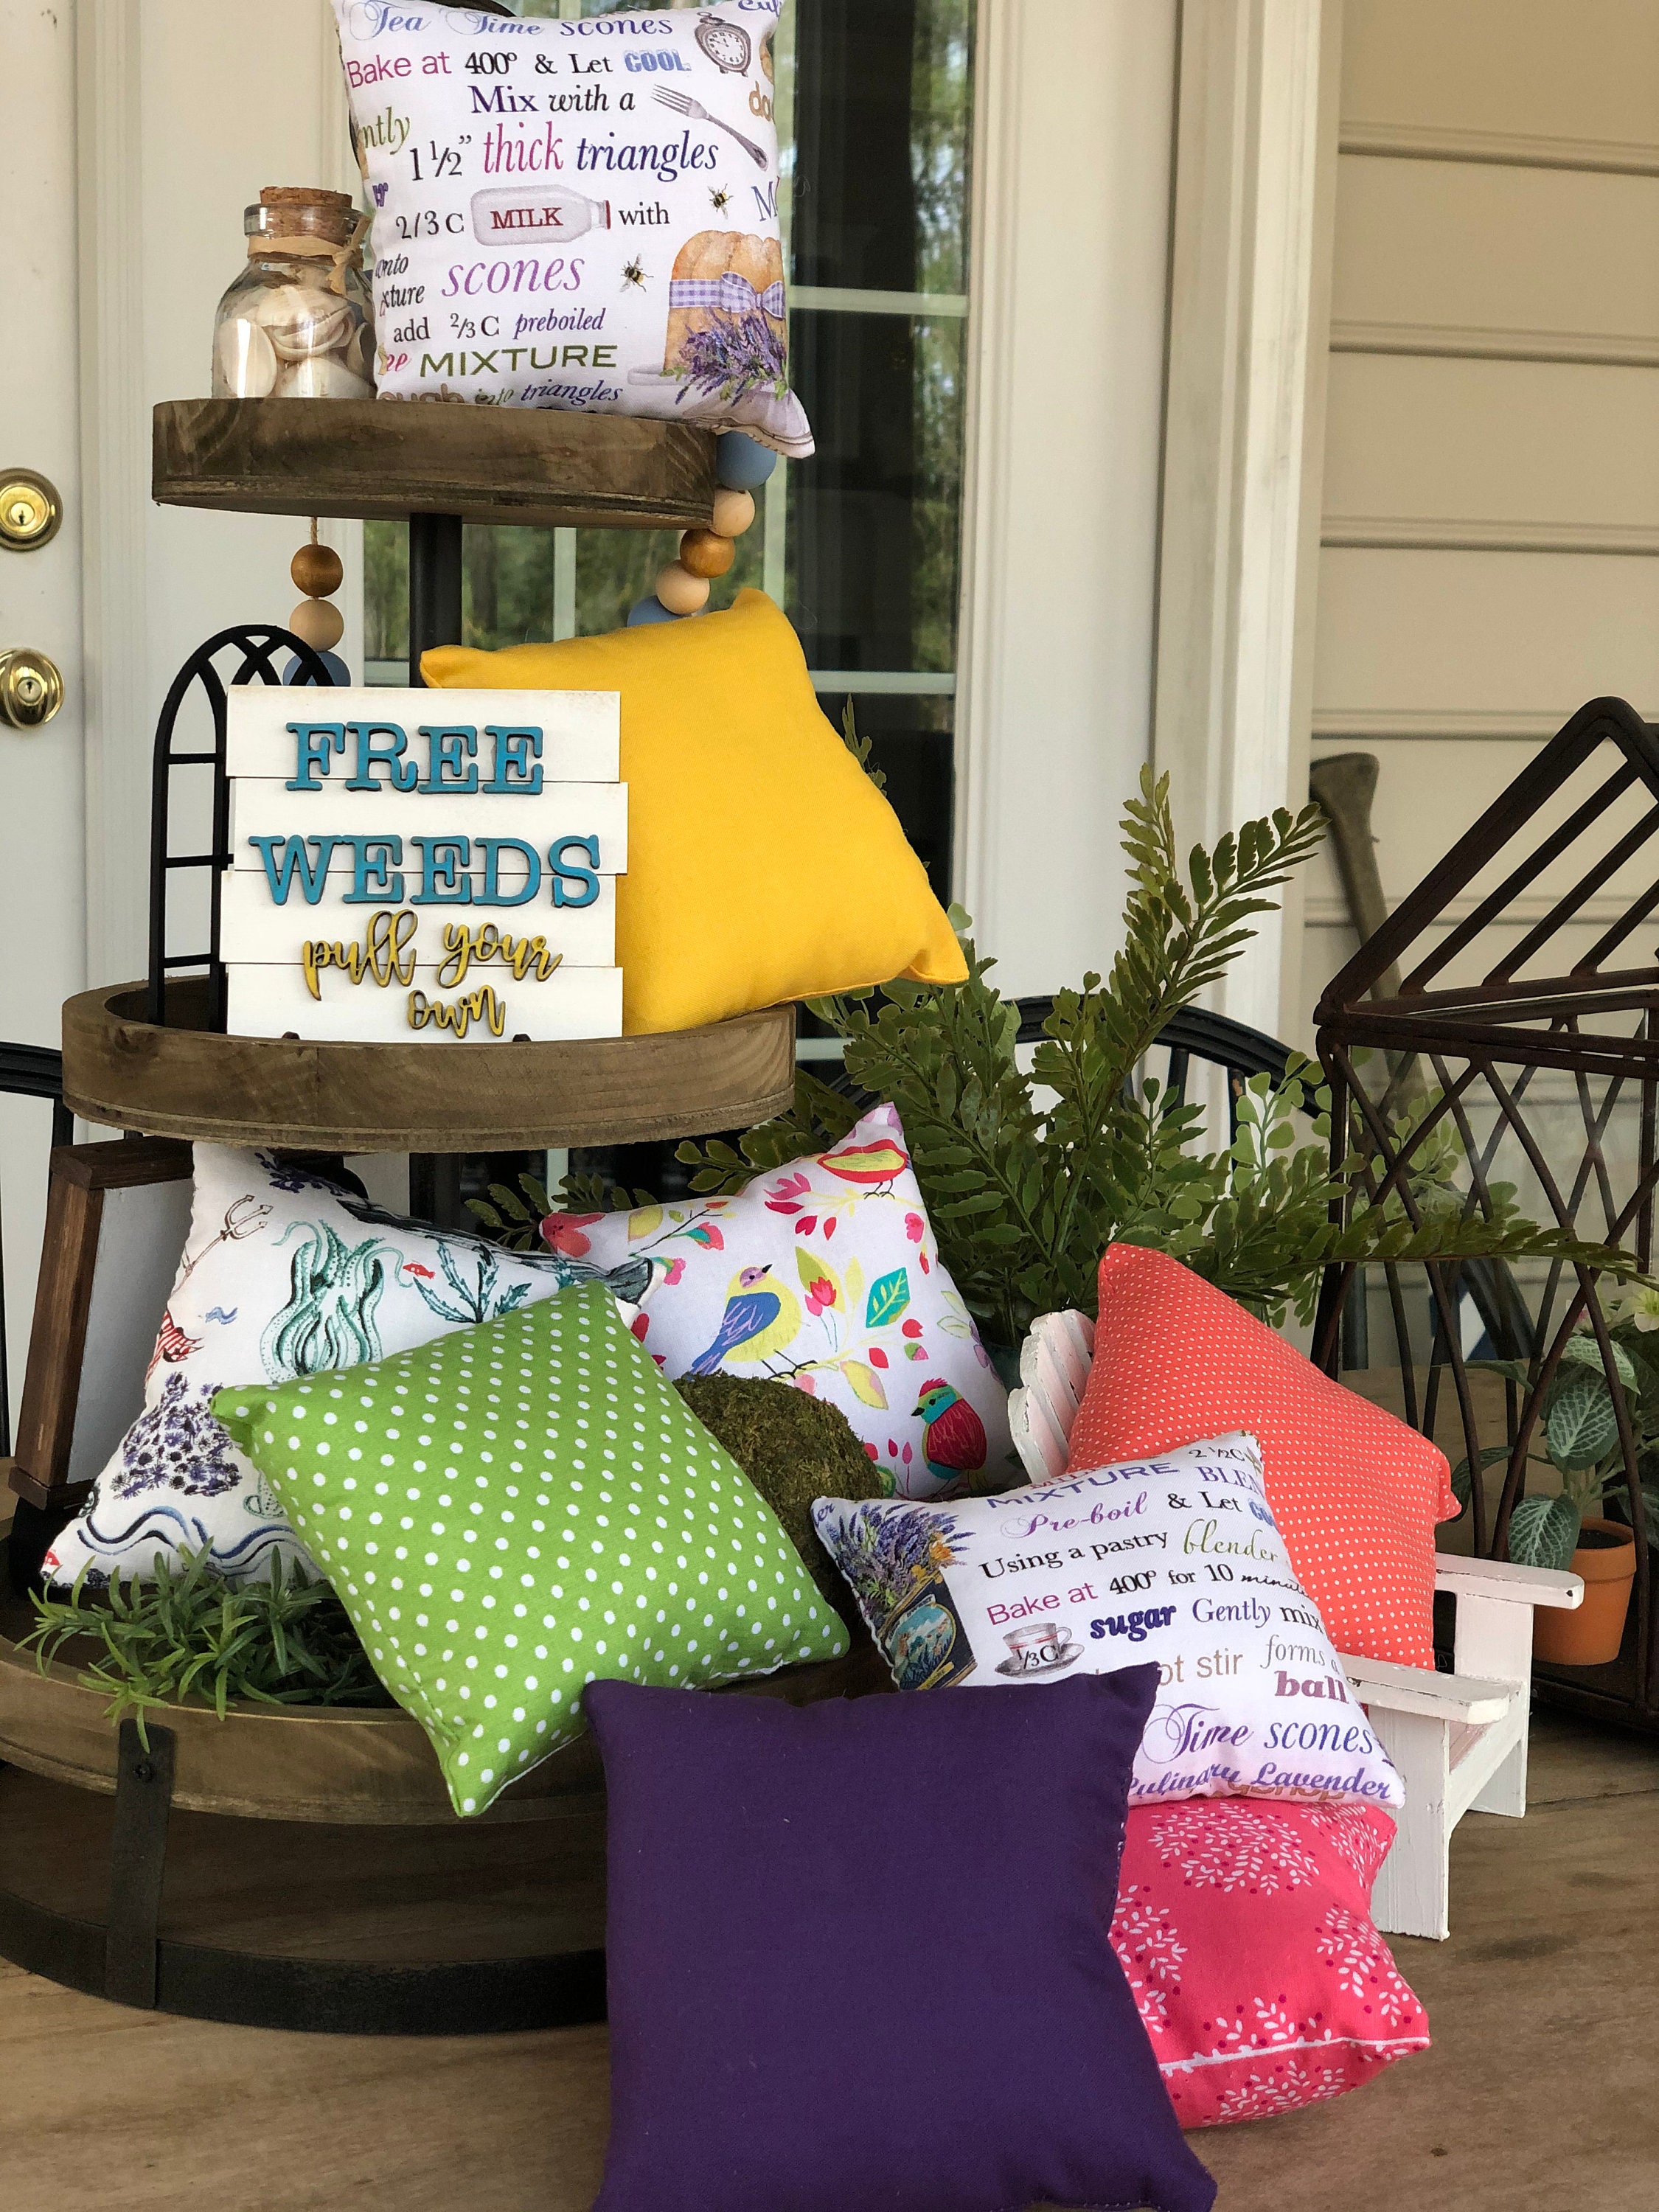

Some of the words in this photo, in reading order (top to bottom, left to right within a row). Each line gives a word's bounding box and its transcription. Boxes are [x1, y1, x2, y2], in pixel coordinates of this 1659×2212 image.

[349, 0, 431, 41] Tea
[444, 10, 544, 35] Time
[560, 18, 673, 37] scones
[347, 54, 411, 88] Bake
[421, 51, 452, 74] at
[535, 54, 557, 74] &
[568, 53, 613, 74] Let
[624, 49, 692, 73] COOL
[467, 85, 540, 114] Mix
[549, 83, 610, 111] with
[619, 91, 636, 110] a
[483, 122, 563, 173] thick
[577, 130, 719, 182] triangles
[490, 207, 564, 230] MILK
[618, 201, 670, 226] with
[442, 258, 585, 298] scones
[393, 316, 431, 343] add
[513, 307, 607, 341] preboiled
[420, 344, 618, 378] MIXTURE
[521, 380, 624, 406] triangles
[285, 721, 543, 796] FREE
[248, 833, 602, 908] WEEDS
[302, 908, 419, 1001] pull
[437, 921, 563, 989] your
[407, 984, 506, 1039] own
[987, 1462, 1180, 1509] MIXTURE
[1000, 1490, 1149, 1540] Pre-boil
[1167, 1492, 1192, 1509] &
[1197, 1491, 1243, 1513] Let
[978, 1552, 1064, 1580] Using
[1068, 1547, 1086, 1560] a
[1091, 1530, 1169, 1562] pastry
[1183, 1518, 1279, 1563] blender
[987, 1595, 1060, 1626] Bake
[1068, 1582, 1099, 1604] at
[1167, 1570, 1197, 1586] for
[1203, 1563, 1234, 1584] 10
[1090, 1602, 1178, 1643] sugar
[1192, 1597, 1271, 1630] Gently
[1279, 1604, 1324, 1634] mix
[1196, 1648, 1244, 1678] stir
[1259, 1634, 1326, 1669] forms
[1274, 1670, 1350, 1705] ball
[1141, 1703, 1253, 1764] Time
[1264, 1722, 1374, 1755] scones
[1249, 1762, 1391, 1800] Lavender
